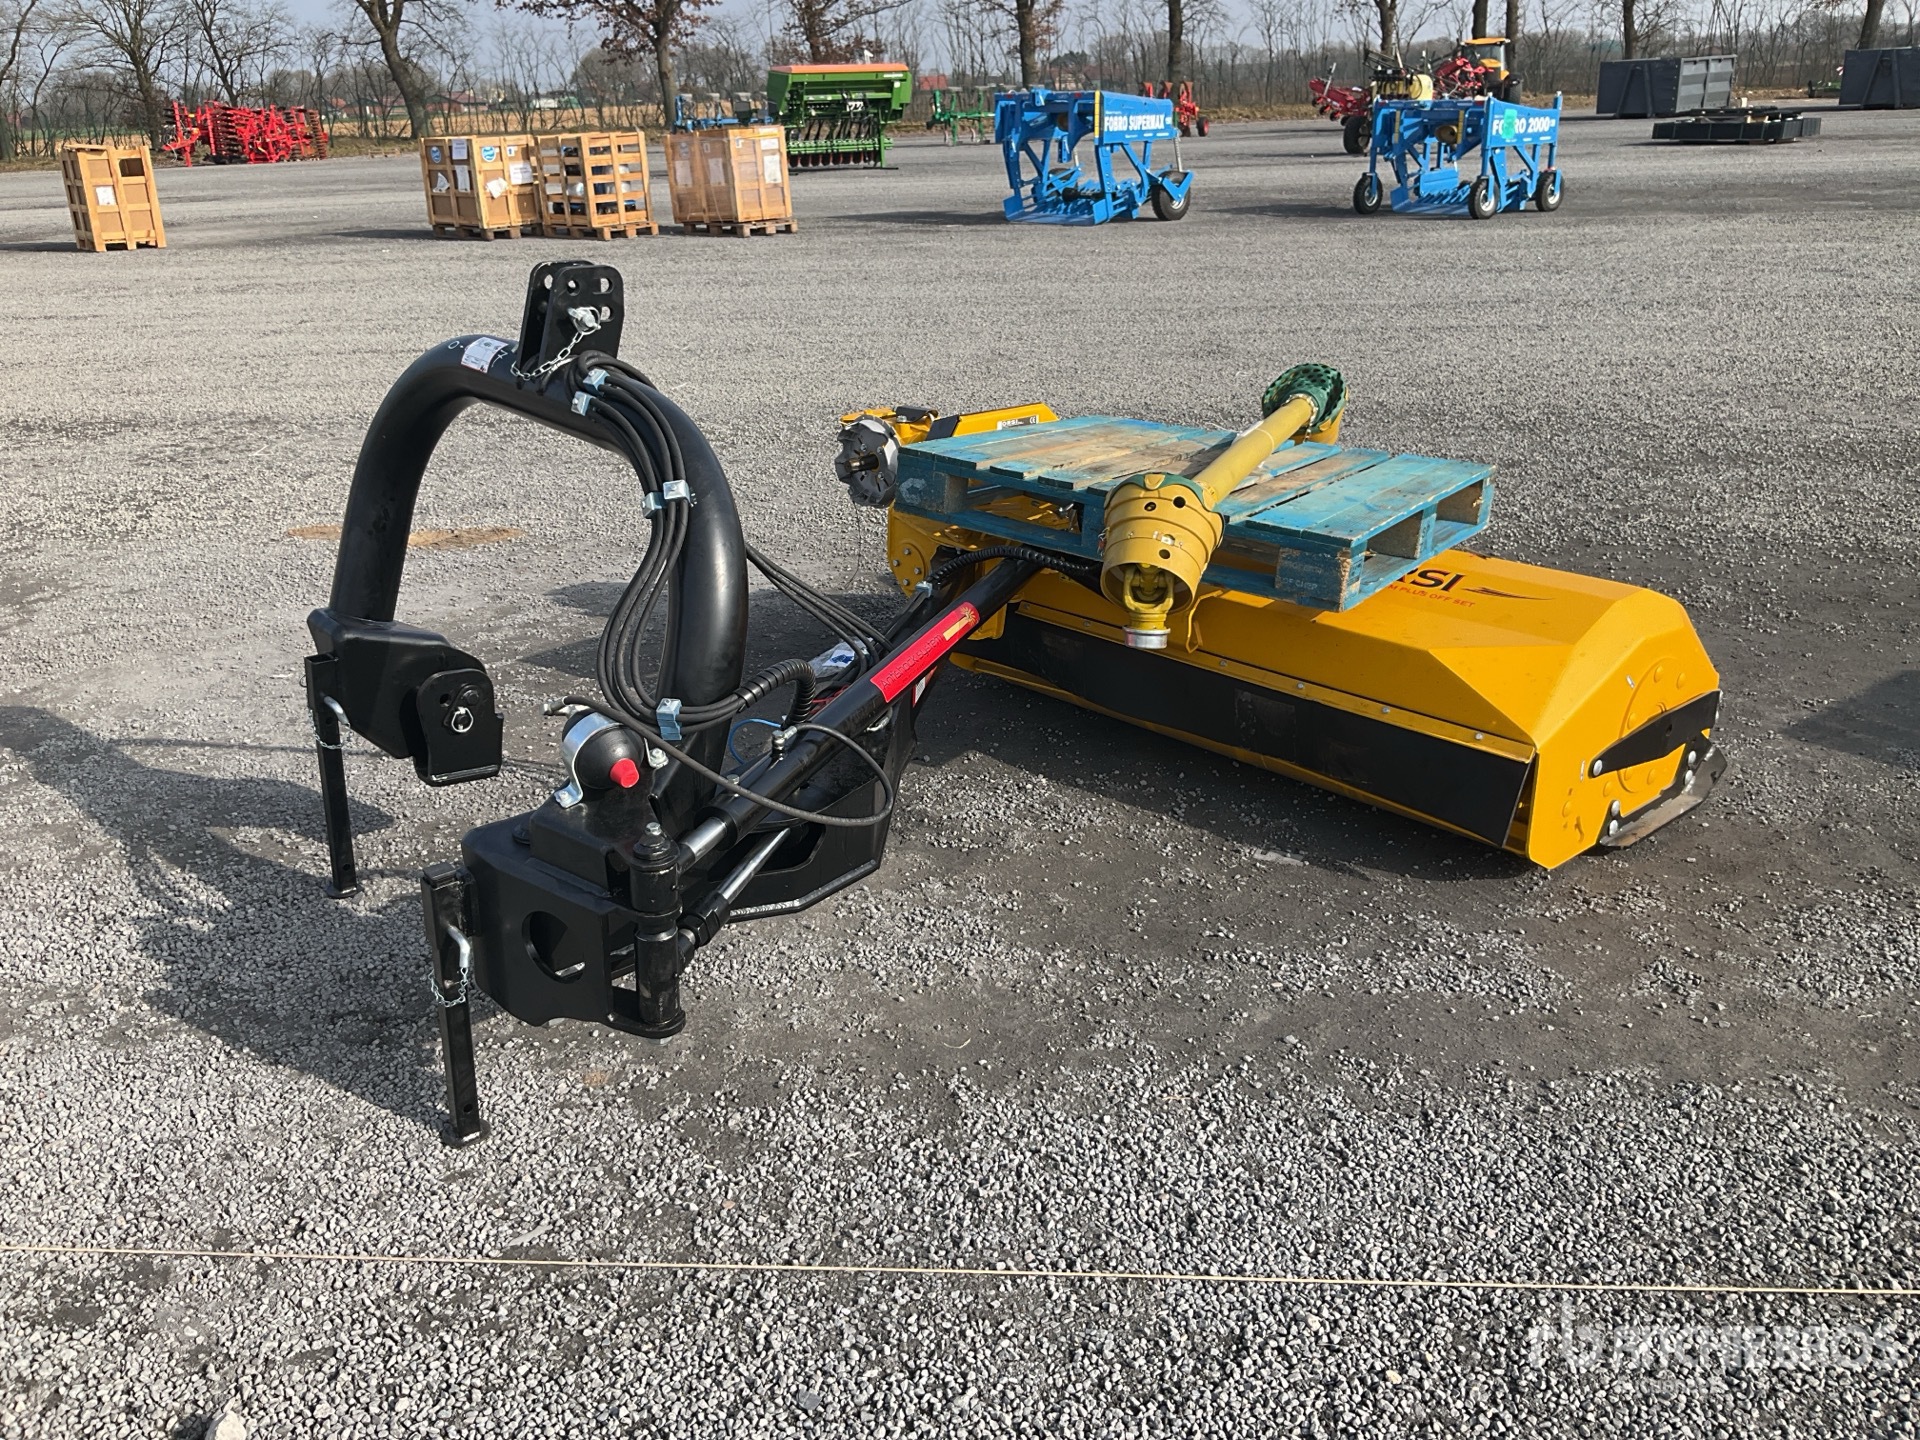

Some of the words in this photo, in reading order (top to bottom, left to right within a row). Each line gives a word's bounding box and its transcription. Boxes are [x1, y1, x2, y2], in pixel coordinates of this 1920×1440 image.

[1104, 115, 1128, 132] FOBRO
[1129, 113, 1165, 131] SUPERMAX
[1492, 118, 1526, 135] FORO
[1527, 116, 1550, 133] 2000
[1399, 586, 1428, 598] PLUS
[1429, 593, 1453, 602] OFF
[1453, 598, 1476, 608] SET
